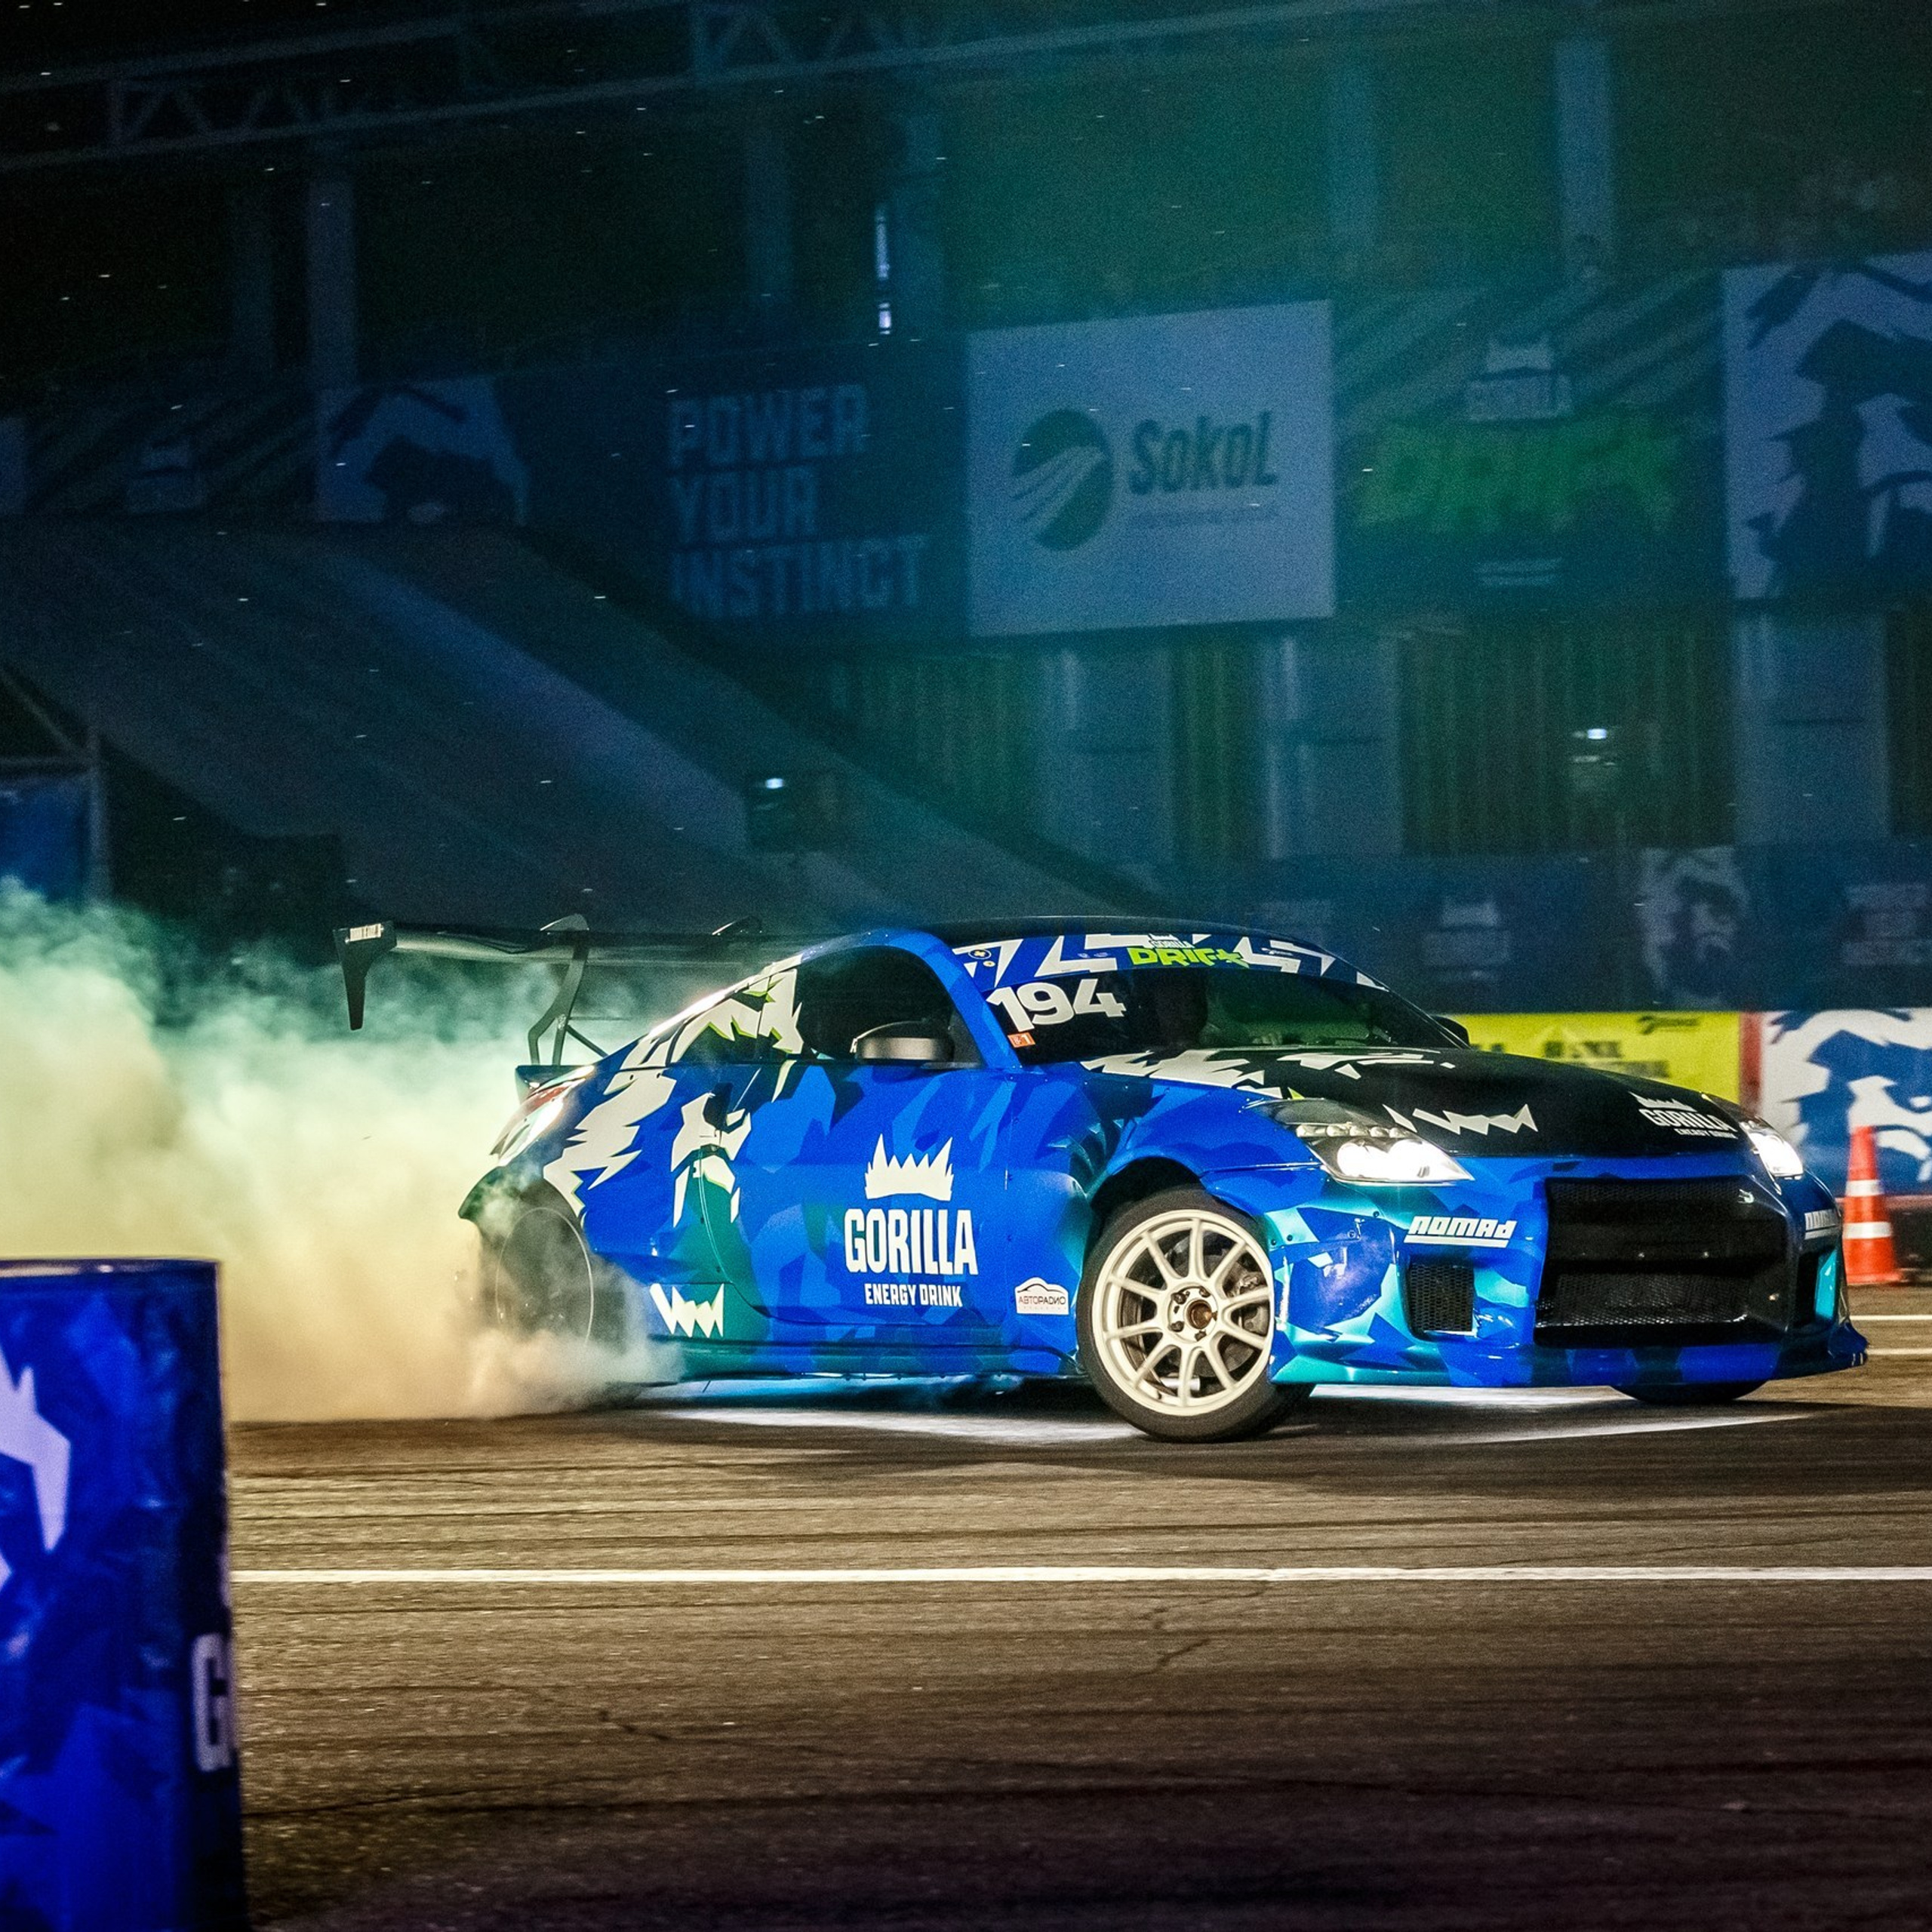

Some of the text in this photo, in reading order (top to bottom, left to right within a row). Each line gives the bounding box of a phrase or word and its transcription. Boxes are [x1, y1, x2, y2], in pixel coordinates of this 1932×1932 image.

[669, 383, 867, 468] POWER
[669, 466, 817, 543] YOUR
[669, 535, 927, 617] INSTINCT
[986, 978, 1127, 1032] 194
[1638, 1109, 1738, 1133] GORILLA
[844, 1208, 979, 1275] GORILLA
[864, 1283, 963, 1307] ENERGY DRINK
[1019, 1296, 1066, 1305] АВТОРАДИО
